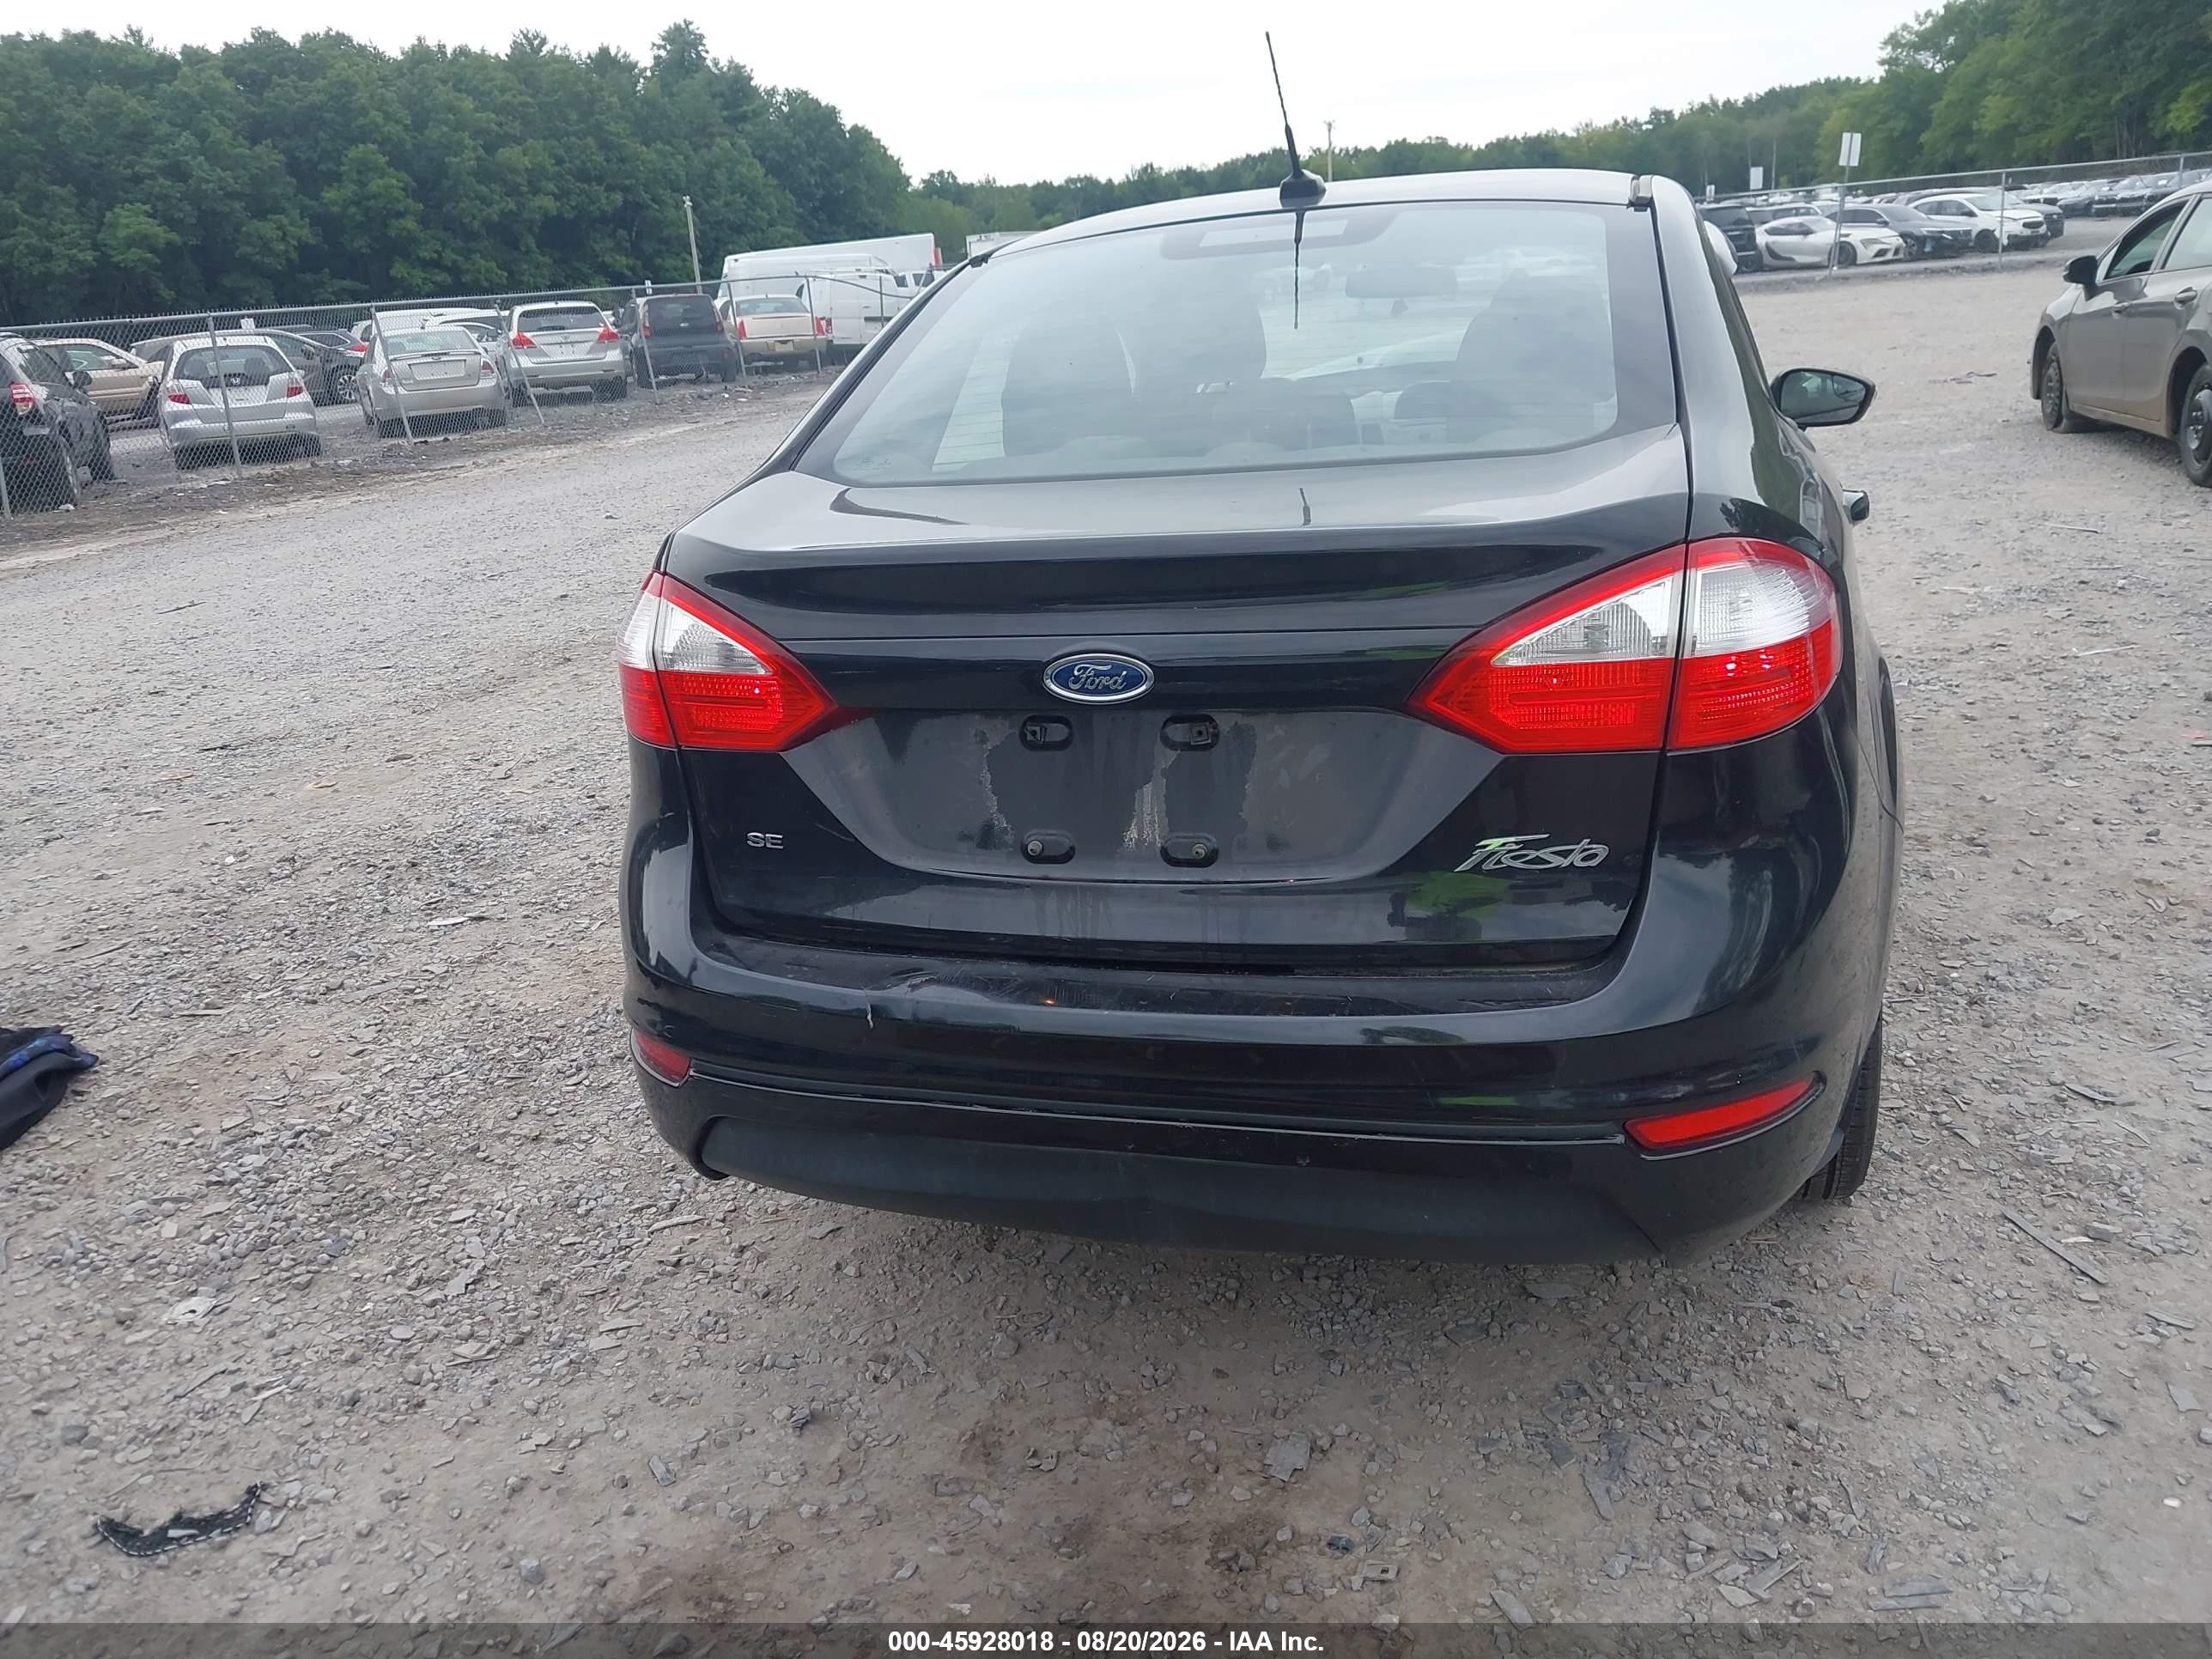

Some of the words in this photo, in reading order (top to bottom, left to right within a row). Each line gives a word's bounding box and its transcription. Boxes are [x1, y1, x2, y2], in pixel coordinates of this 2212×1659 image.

[1068, 664, 1127, 690] Ford
[746, 832, 784, 849] SE
[1453, 833, 1610, 872] Fiesta
